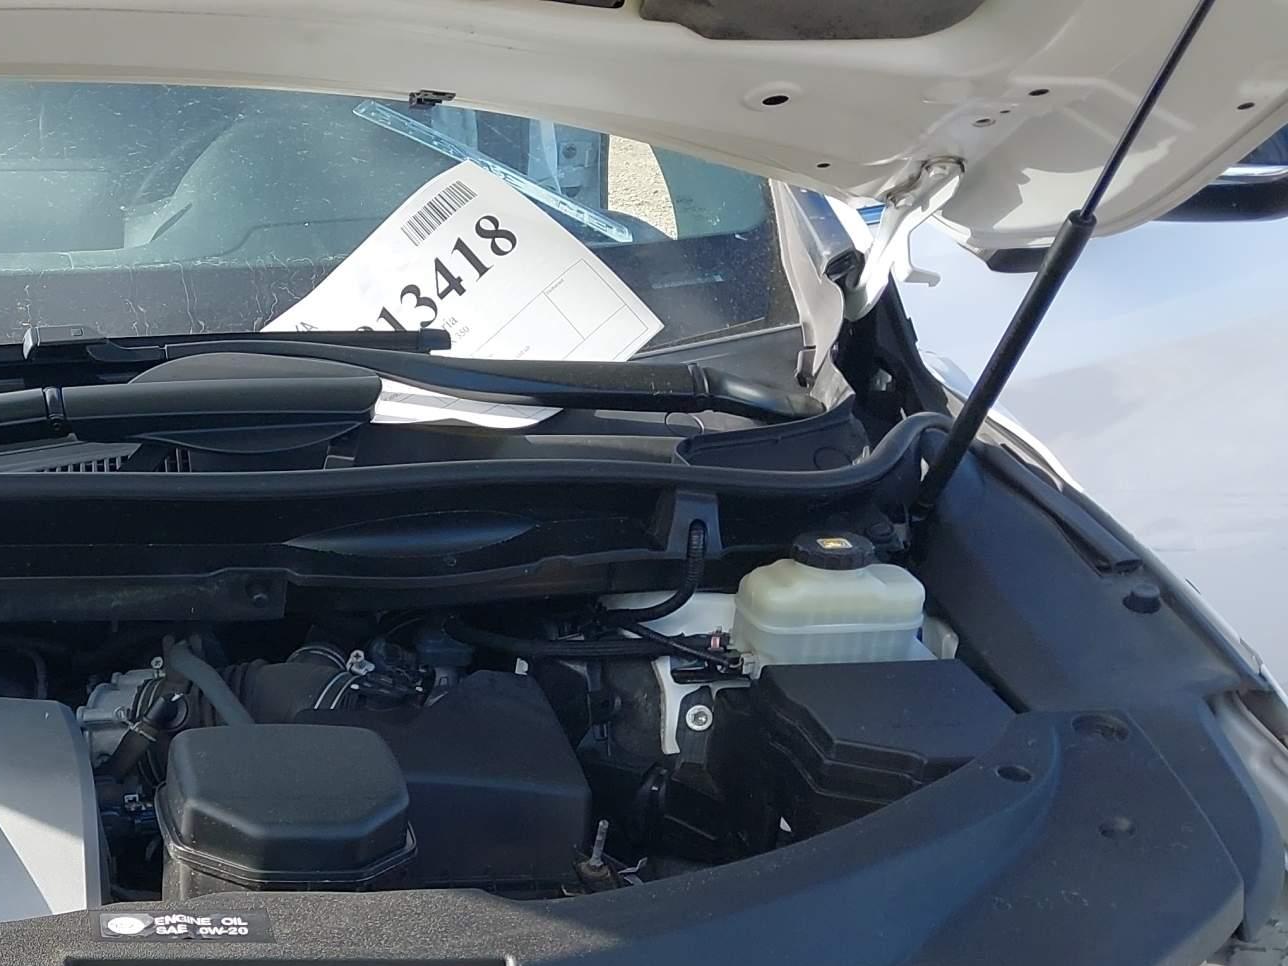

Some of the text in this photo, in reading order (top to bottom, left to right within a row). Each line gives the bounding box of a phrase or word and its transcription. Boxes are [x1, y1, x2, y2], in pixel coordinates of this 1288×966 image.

[356, 215, 517, 332] 13418
[154, 914, 248, 926] ENGINE OIL
[156, 924, 248, 935] SAE 0W-20
